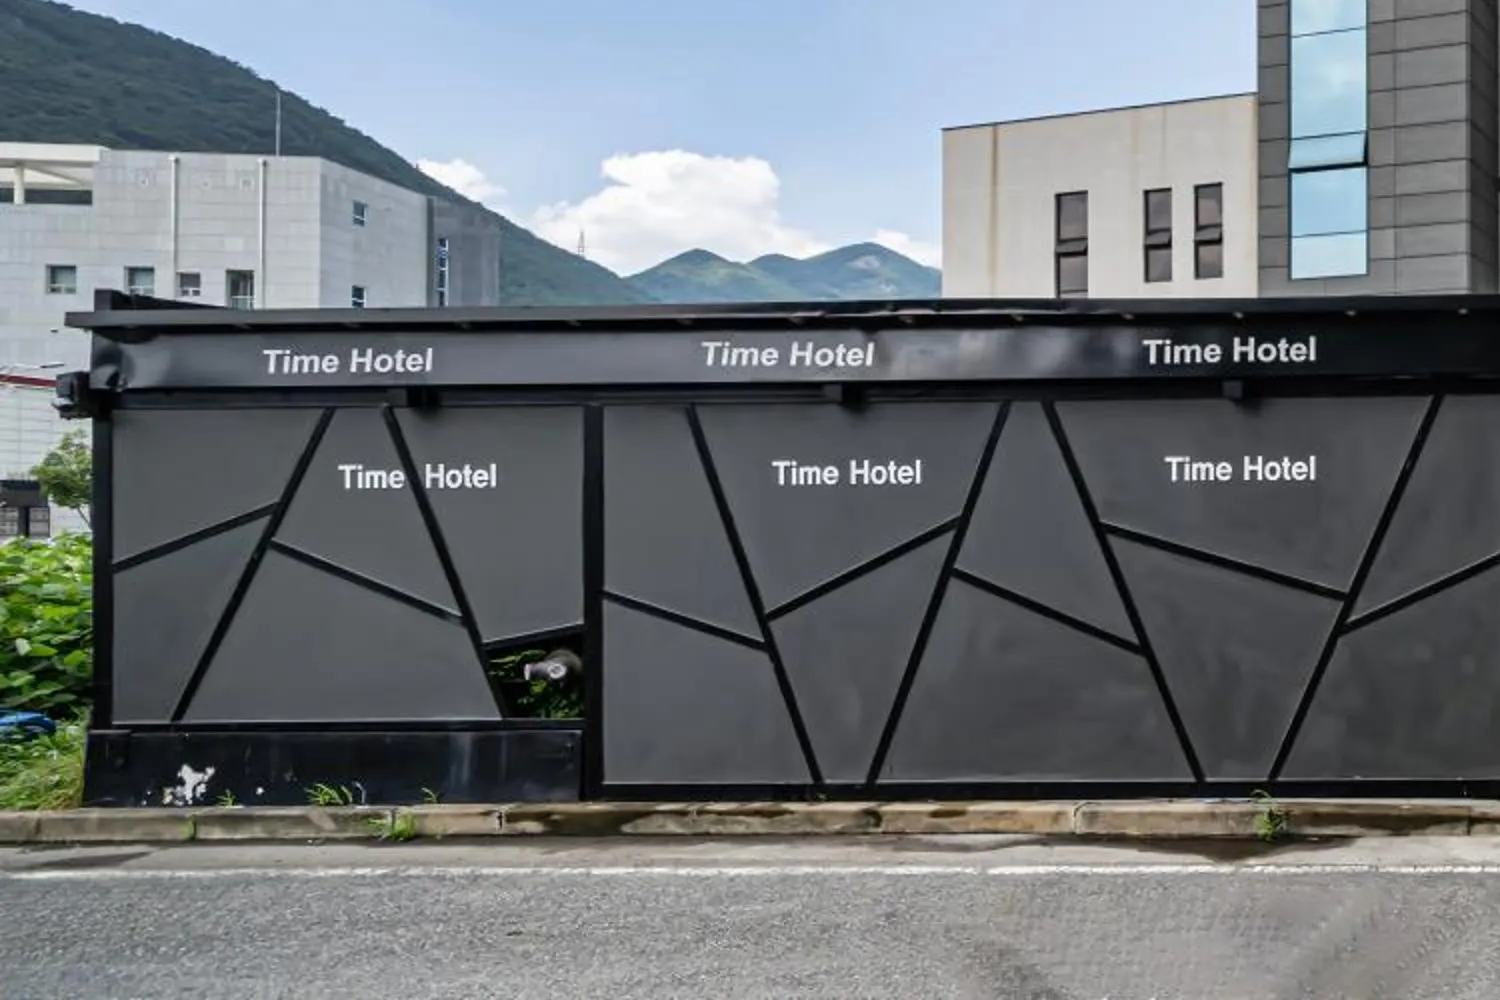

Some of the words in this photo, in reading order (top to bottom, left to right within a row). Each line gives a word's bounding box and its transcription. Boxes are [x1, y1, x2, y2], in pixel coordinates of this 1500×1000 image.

[263, 349, 339, 374] Time
[349, 347, 433, 373] Hotel
[702, 341, 779, 367] Time
[789, 341, 874, 367] Hotel
[1142, 339, 1222, 365] Time
[1232, 336, 1316, 362] Hotel
[337, 464, 405, 489] Time
[424, 463, 497, 489] Hotel
[771, 460, 839, 486] Time
[849, 459, 921, 485] Hotel
[1164, 456, 1233, 482] Time
[1242, 455, 1316, 481] Hotel
